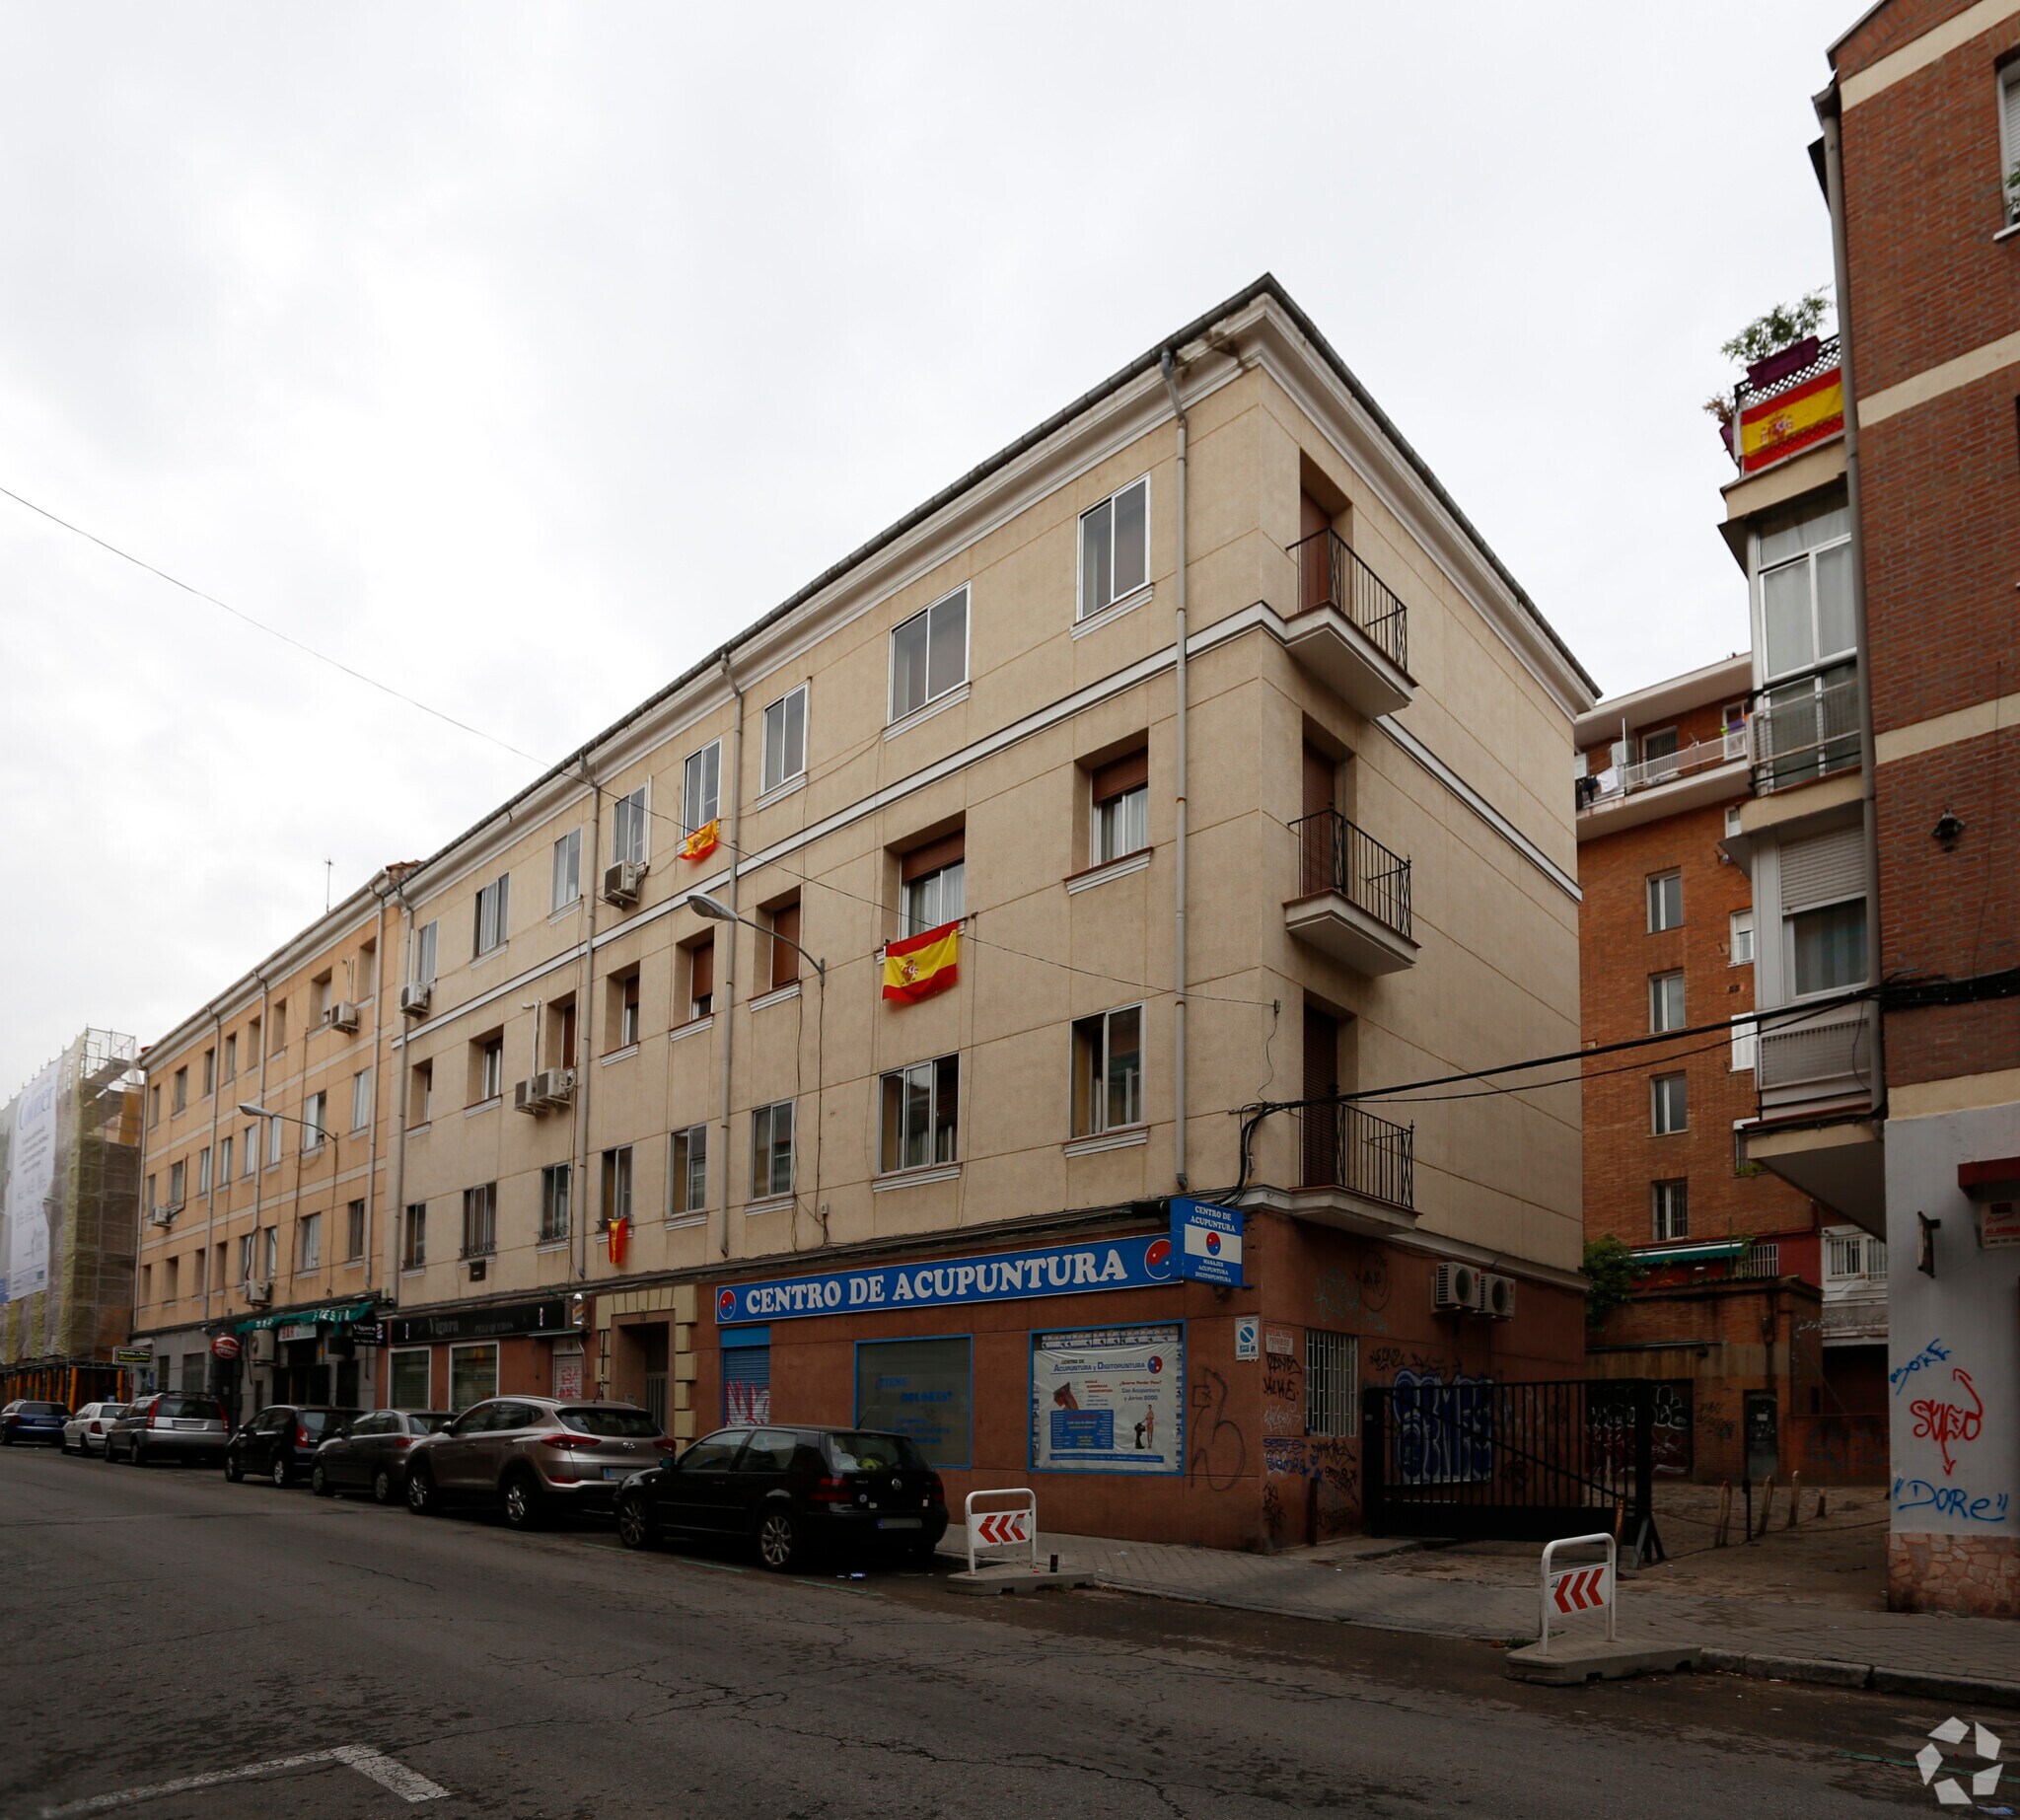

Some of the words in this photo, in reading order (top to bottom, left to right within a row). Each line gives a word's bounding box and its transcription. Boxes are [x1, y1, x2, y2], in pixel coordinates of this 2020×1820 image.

[1194, 1205, 1222, 1218] CENTRO
[1222, 1212, 1232, 1221] DE
[1190, 1215, 1236, 1233] ACUPUNTURA
[1197, 1265, 1229, 1275] ACUPUNTURA
[1202, 1259, 1224, 1268] MASAJES
[746, 1280, 842, 1314] CENTRO
[848, 1274, 885, 1305] DE
[892, 1249, 1128, 1301] ACUPUNTURA
[1194, 1271, 1232, 1283] DIGITOPUNTURA
[428, 1317, 460, 1336] Vigara
